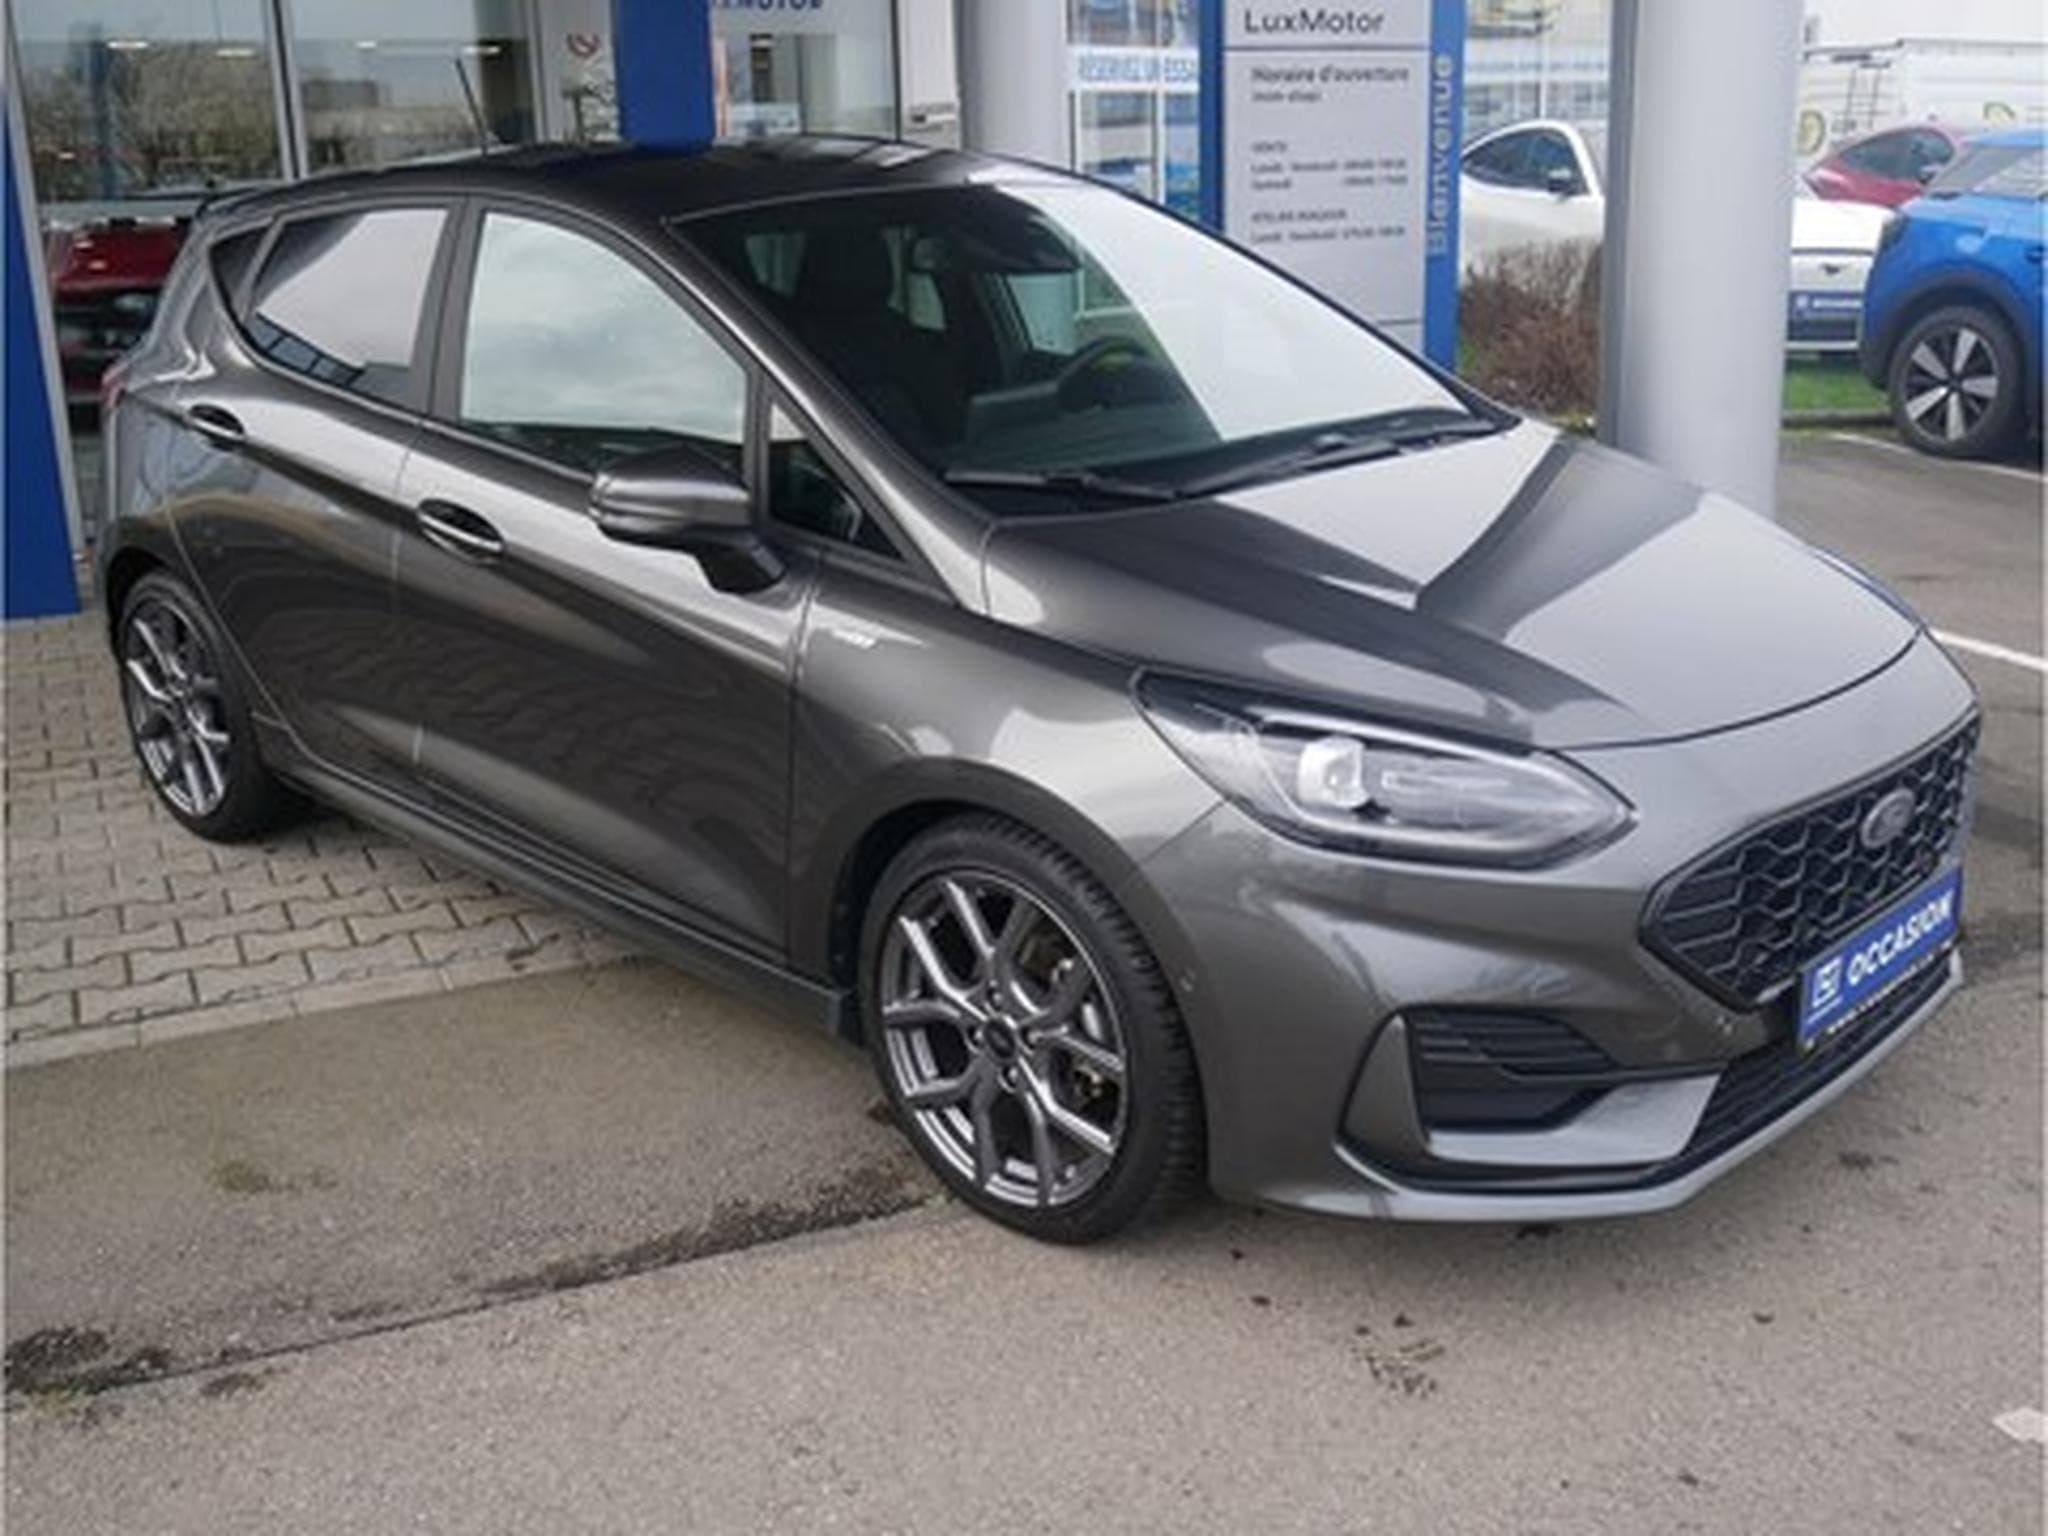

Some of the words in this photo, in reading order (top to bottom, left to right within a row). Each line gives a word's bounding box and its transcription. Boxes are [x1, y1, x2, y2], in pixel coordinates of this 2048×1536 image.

[1244, 8, 1384, 34] LuxMotor
[1427, 54, 1453, 256] Bienvenue
[1847, 888, 1955, 986] OCCASION
